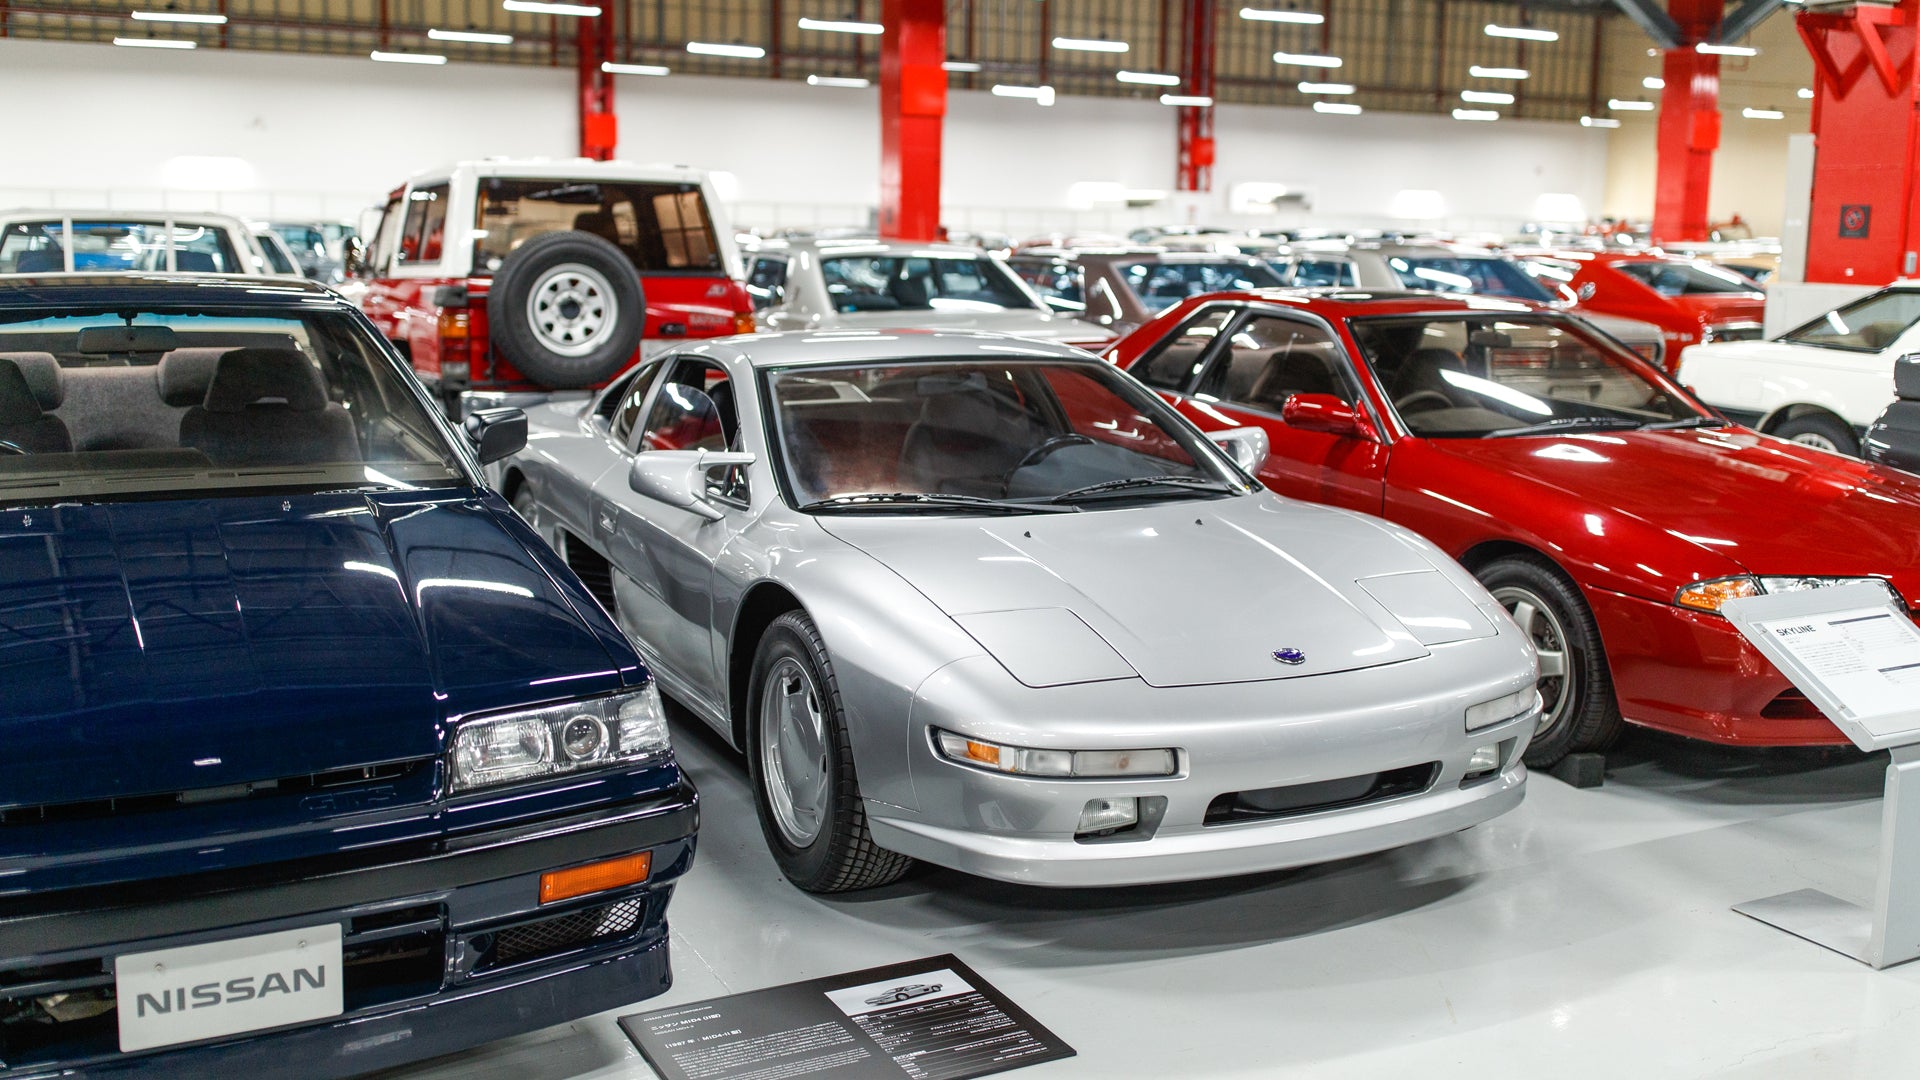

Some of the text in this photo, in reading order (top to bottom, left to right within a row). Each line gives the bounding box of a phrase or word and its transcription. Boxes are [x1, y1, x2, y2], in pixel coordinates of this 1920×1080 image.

[1776, 625, 1816, 636] SKYLINE
[136, 965, 325, 1018] NISSAN
[651, 1022, 679, 1031] ニッサン
